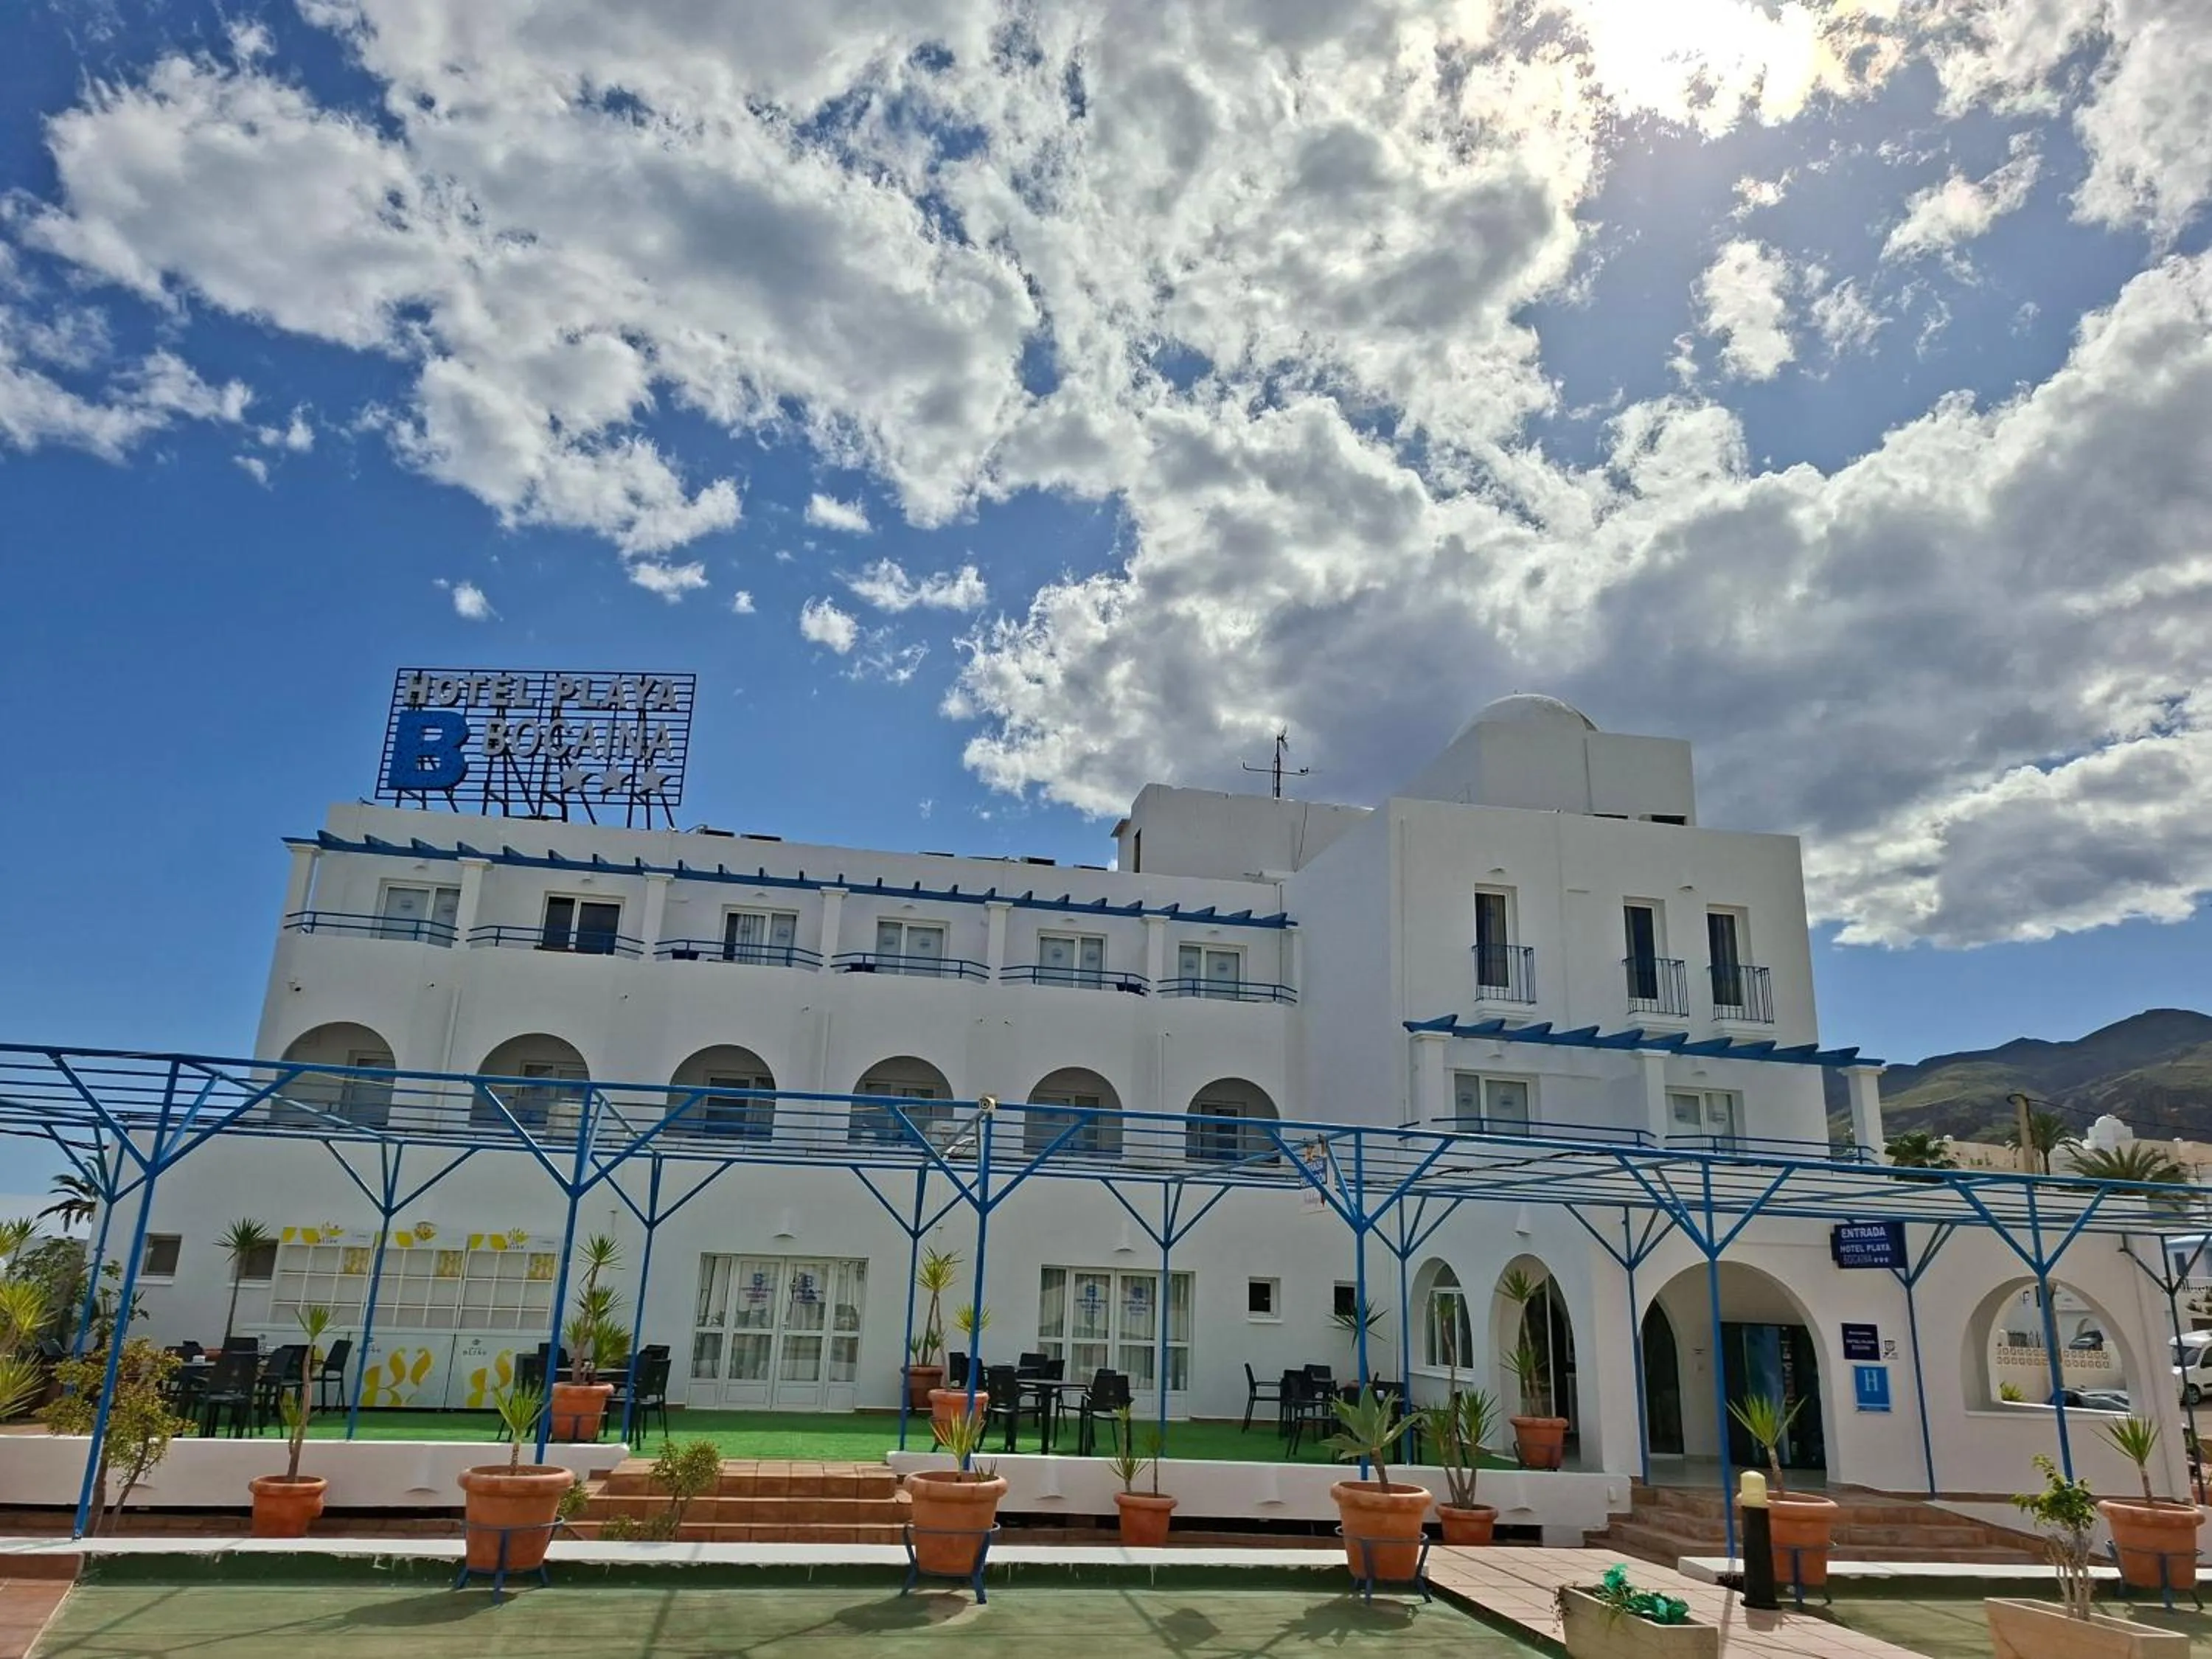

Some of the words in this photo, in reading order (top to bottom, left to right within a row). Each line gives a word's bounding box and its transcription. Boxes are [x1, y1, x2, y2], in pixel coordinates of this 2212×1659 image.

[403, 673, 536, 707] HOTEL
[553, 676, 678, 710] PLAYA
[388, 710, 470, 790] B
[481, 717, 674, 762] BOCAINA
[1840, 1226, 1887, 1239] ENTRADA
[1840, 1244, 1865, 1253] HOTEL
[1866, 1243, 1892, 1252] PLAYA
[1864, 1369, 1879, 1392] H
